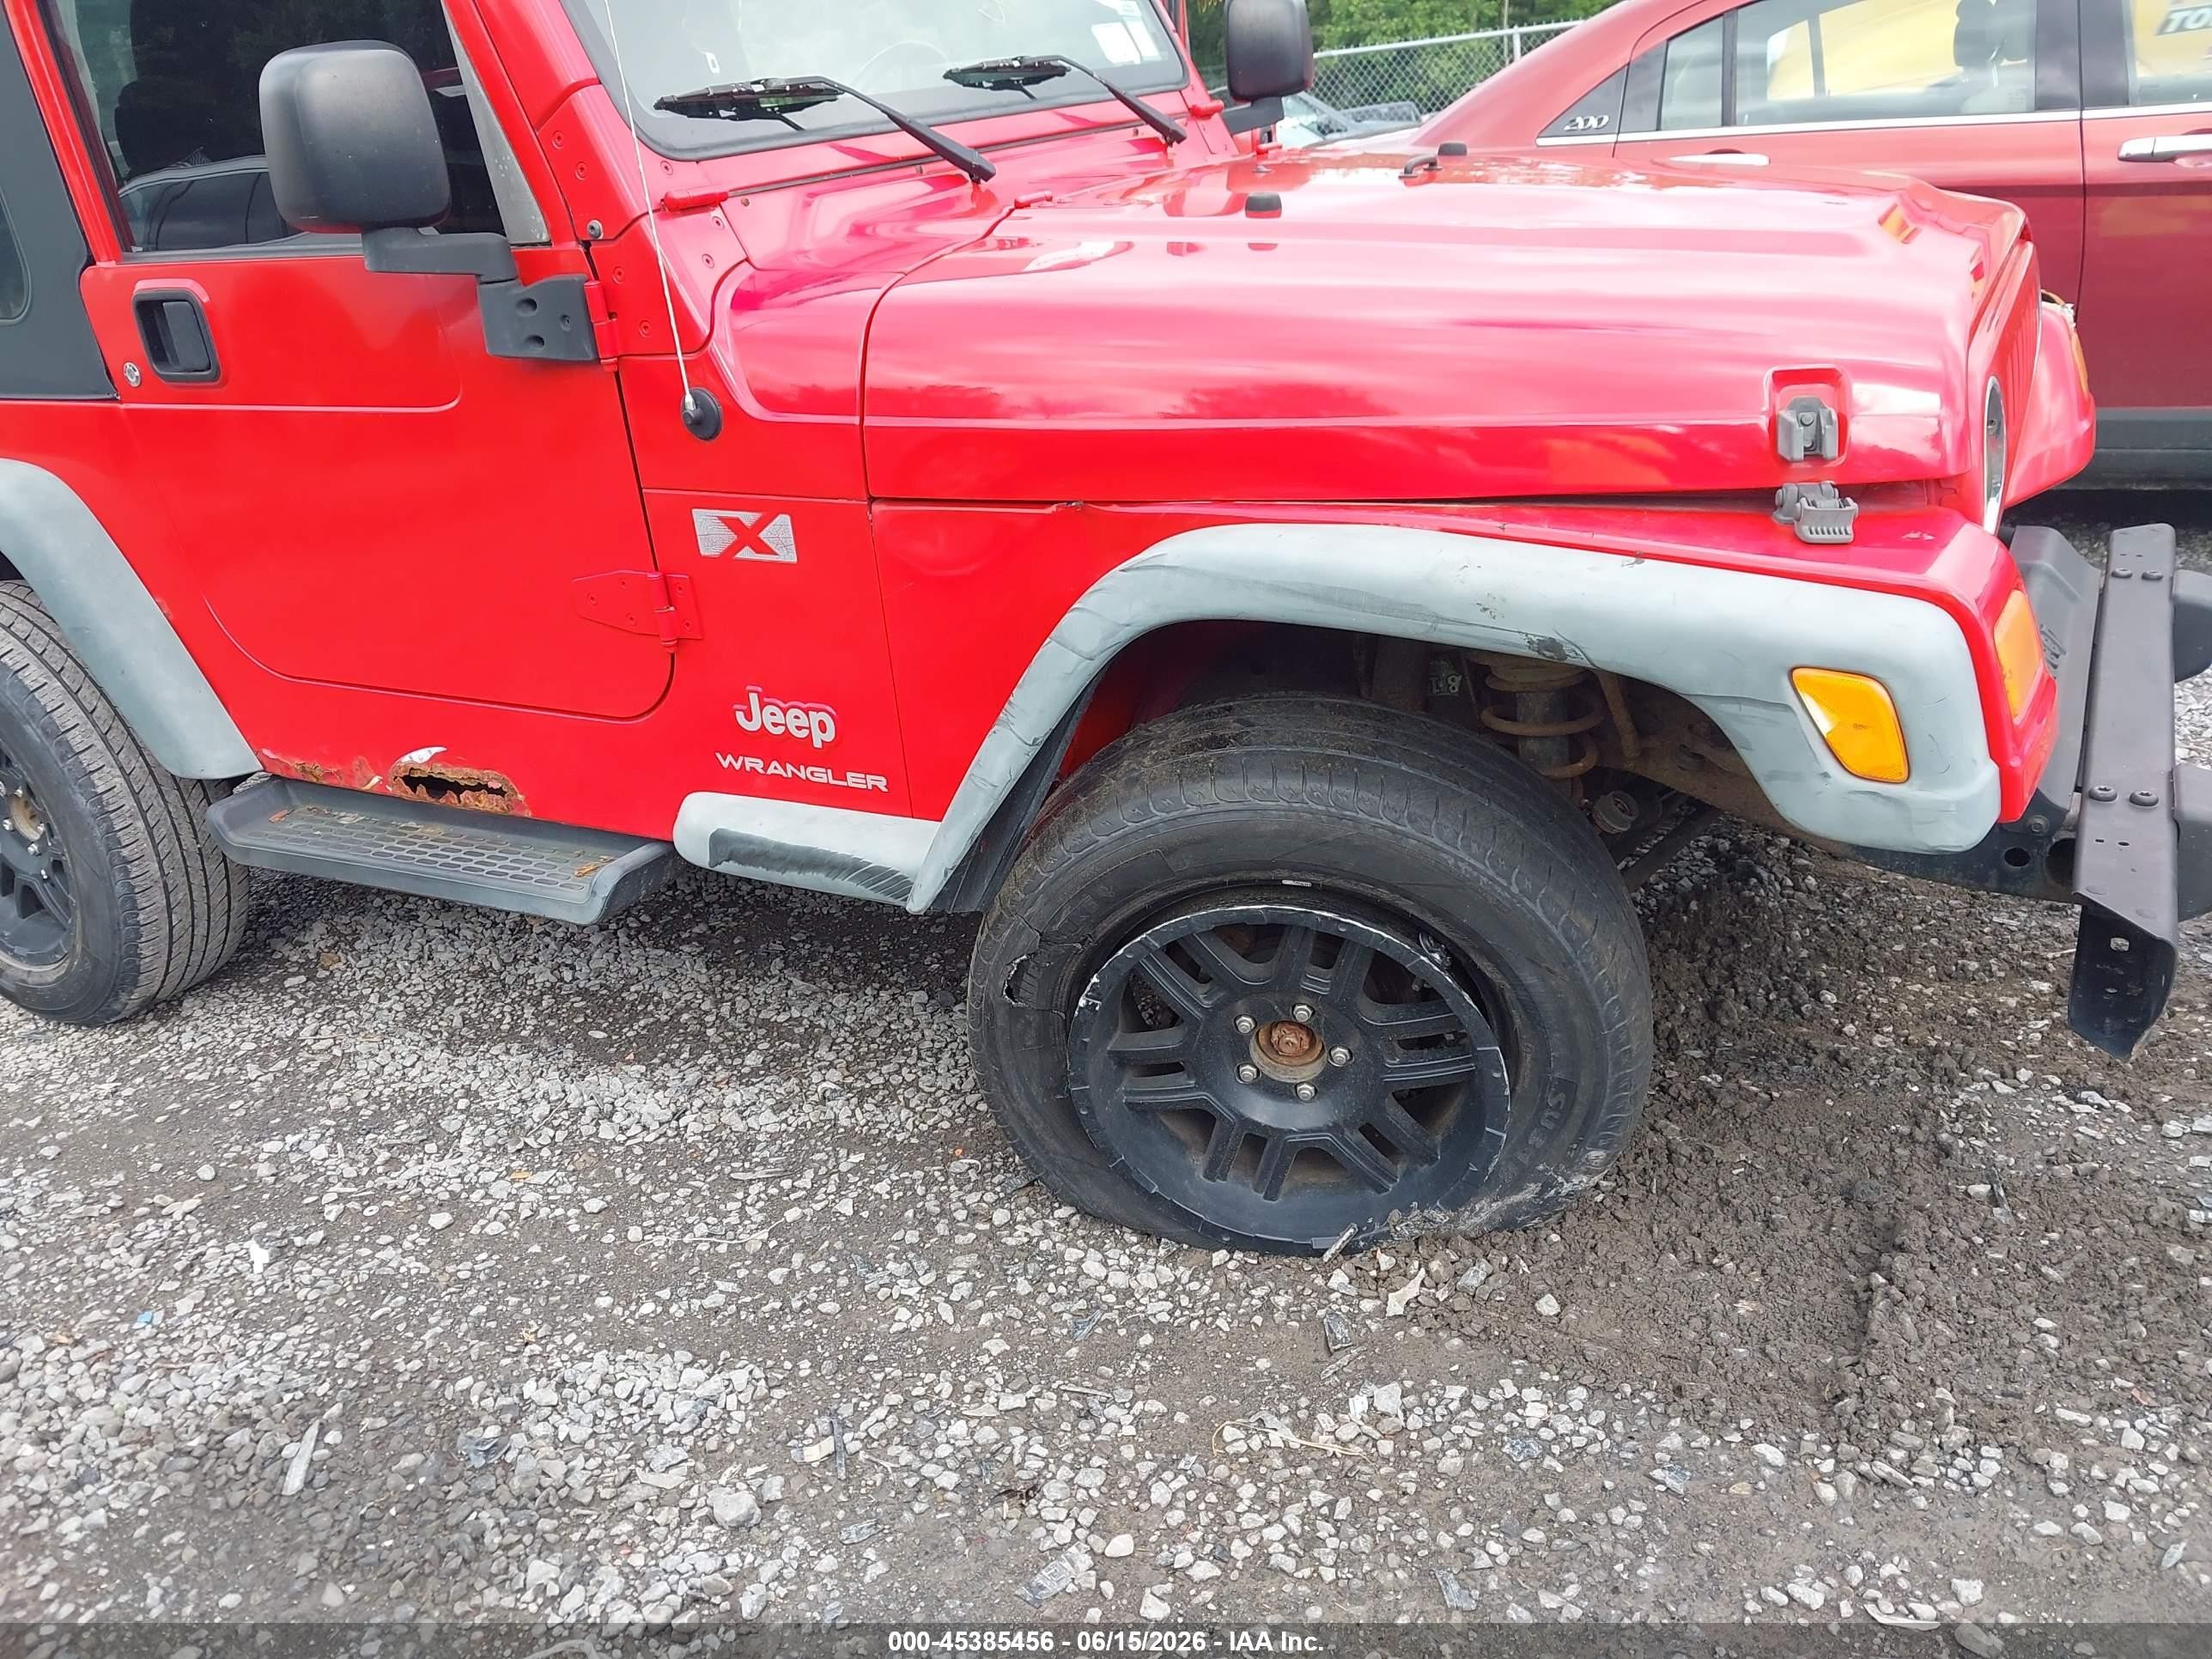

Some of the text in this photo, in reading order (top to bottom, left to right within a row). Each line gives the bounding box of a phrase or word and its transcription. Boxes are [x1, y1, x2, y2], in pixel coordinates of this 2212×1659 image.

[2163, 6, 2212, 33] TO
[1564, 114, 1609, 131] 200
[709, 510, 785, 561] X
[735, 691, 836, 749] Jeep
[715, 751, 889, 792] WRANGLER
